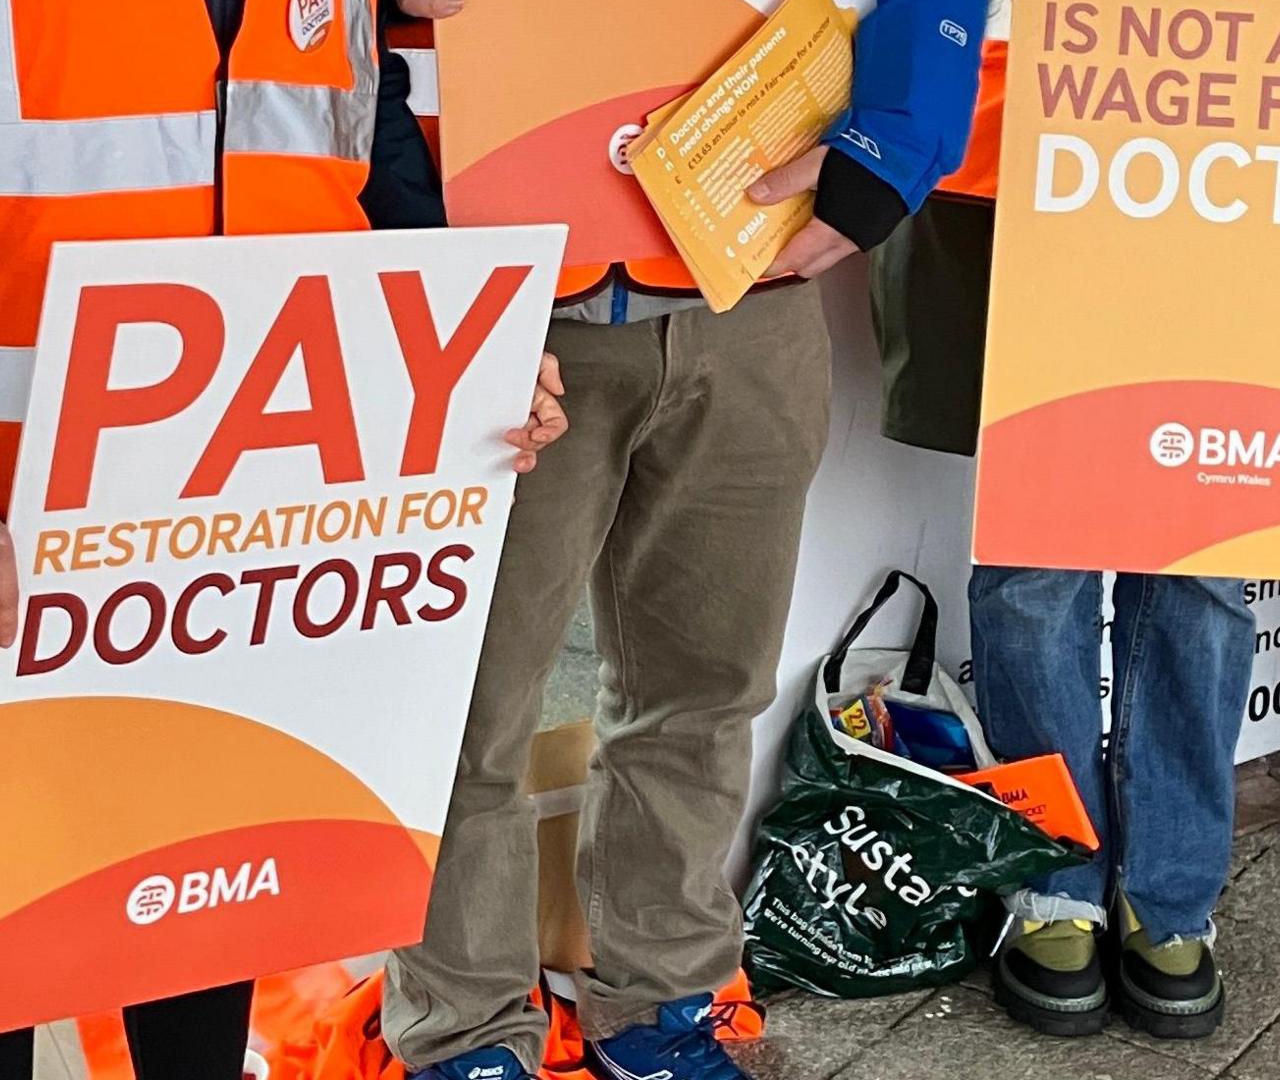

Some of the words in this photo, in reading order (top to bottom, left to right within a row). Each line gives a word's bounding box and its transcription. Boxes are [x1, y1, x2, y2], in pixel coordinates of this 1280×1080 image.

[1044, 2, 1100, 55] IS
[1119, 6, 1254, 62] NOT
[669, 107, 708, 145] Doctors
[705, 85, 726, 108] and
[723, 63, 749, 91] their
[747, 26, 787, 70] patients
[678, 127, 703, 157] need
[700, 97, 735, 131] change
[733, 71, 760, 100] NOW
[1037, 63, 1237, 128] WAGE
[746, 210, 769, 237] BMA
[43, 265, 534, 512] PAY
[1197, 472, 1236, 486] Cymru
[1237, 475, 1271, 487] Wales
[32, 497, 386, 575] RESTORATION
[396, 486, 488, 535] FOR
[16, 543, 475, 677] DOCTORS
[177, 857, 280, 914] BMA
[771, 896, 791, 917] This
[790, 912, 808, 932] bag
[763, 907, 788, 930] We're
[787, 926, 822, 956] turning
